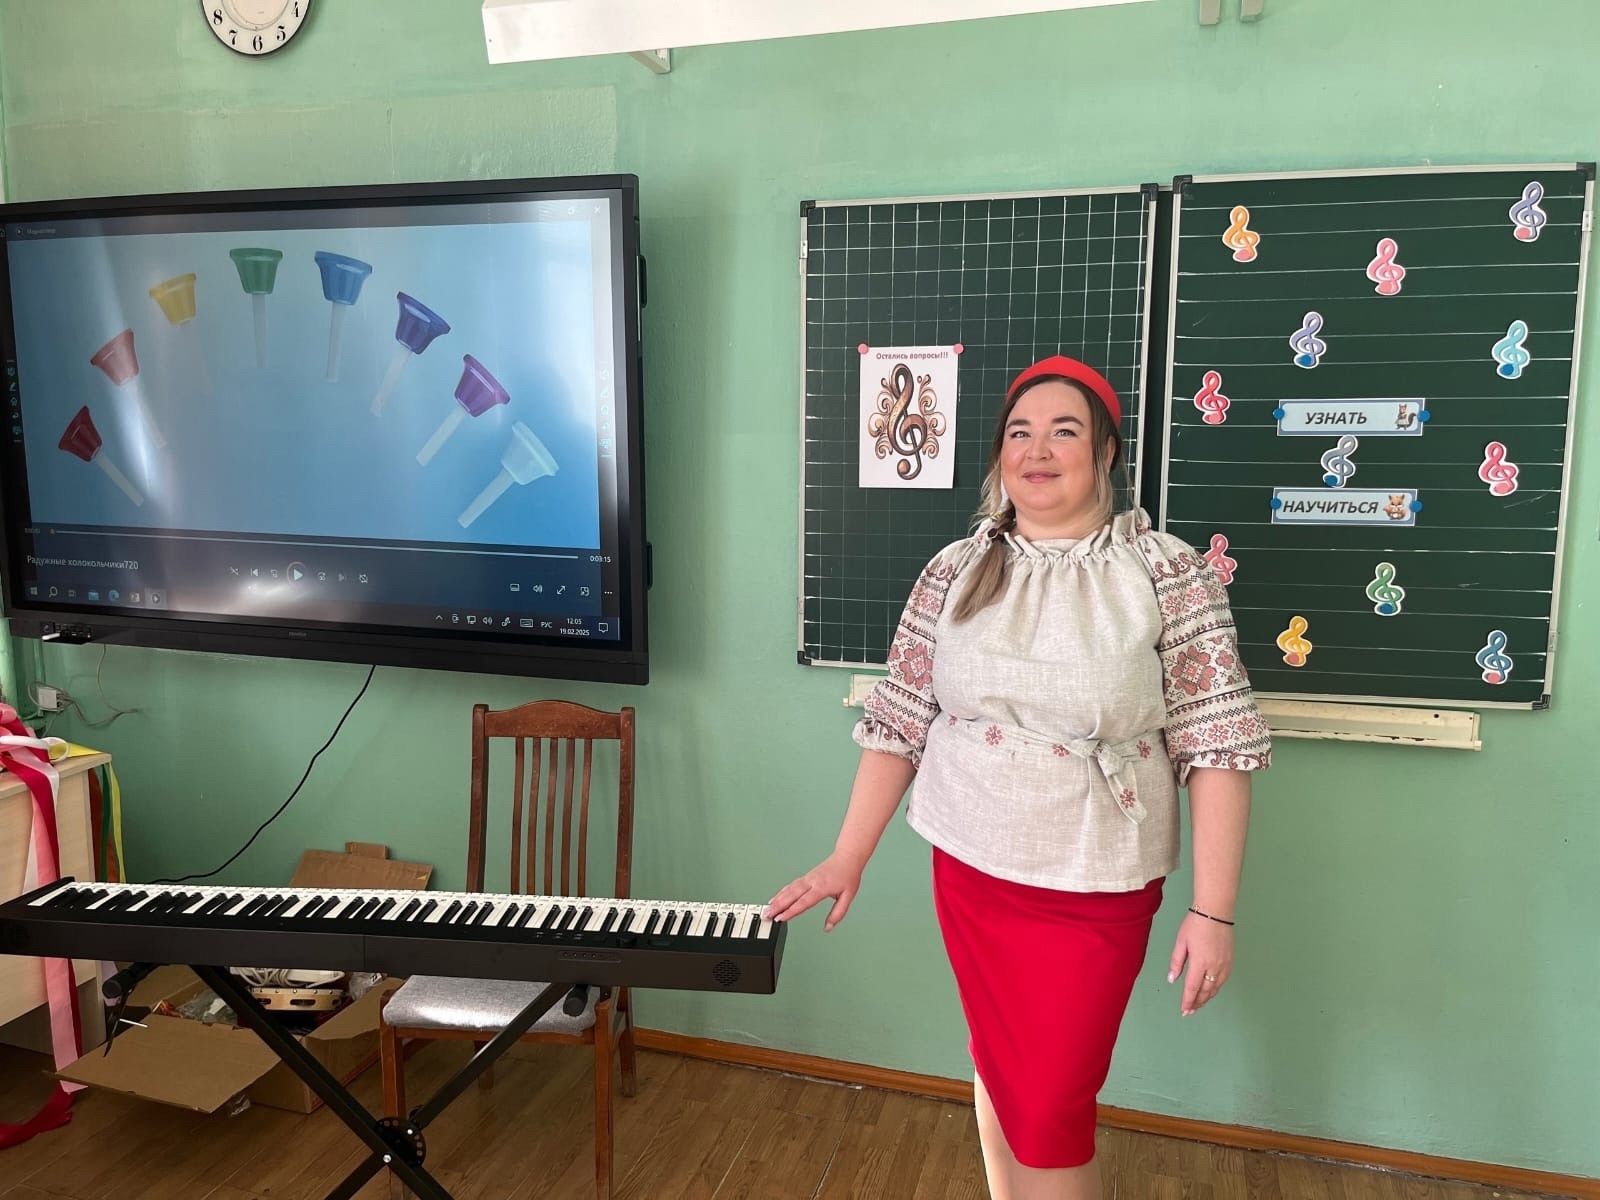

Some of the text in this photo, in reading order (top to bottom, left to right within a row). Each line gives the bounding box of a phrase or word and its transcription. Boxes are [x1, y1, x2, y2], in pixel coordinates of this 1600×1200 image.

[213, 9, 223, 25] 8
[291, 1, 300, 18] 4
[228, 29, 238, 45] 7
[276, 25, 286, 41] 5
[252, 34, 263, 52] 6
[876, 351, 949, 361] Остались вопросы!!!
[1304, 412, 1367, 425] УЗНАТЬ
[1282, 500, 1378, 514] НАУЧИТЬСЯ
[27, 555, 67, 567] Радужные
[559, 627, 590, 636] 19.02.2025
